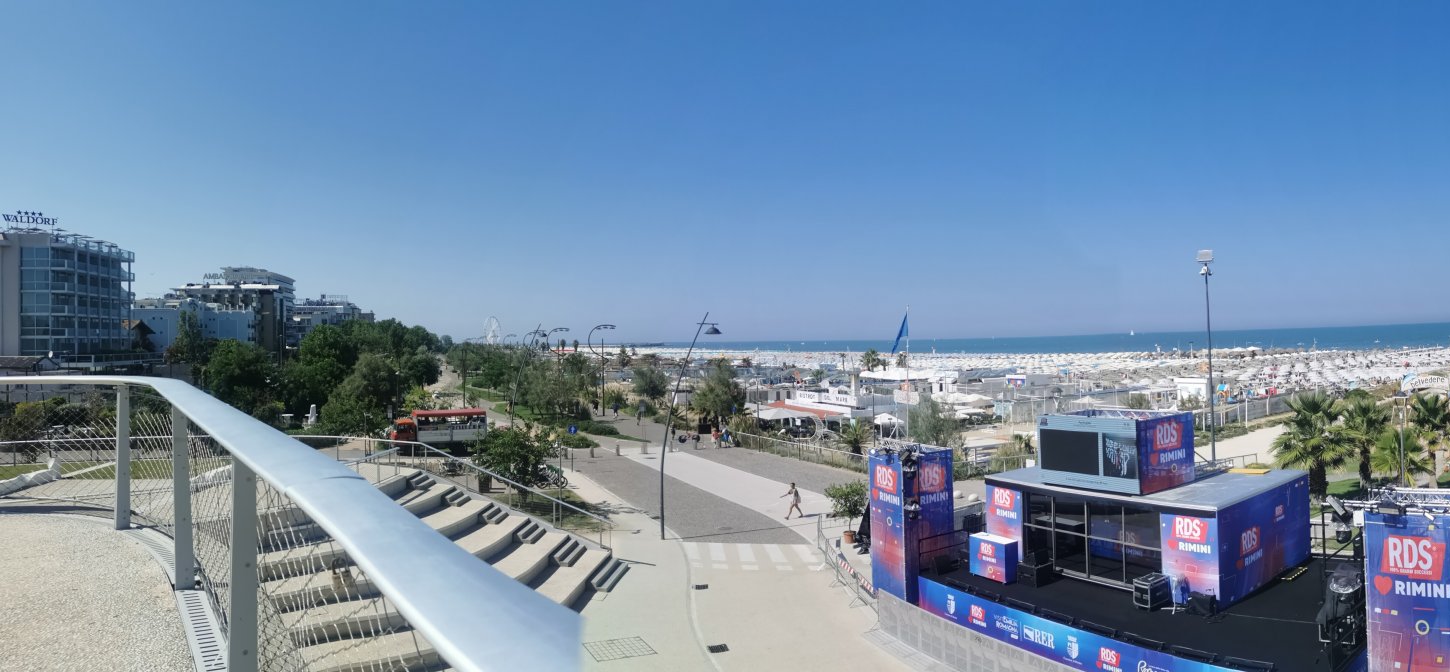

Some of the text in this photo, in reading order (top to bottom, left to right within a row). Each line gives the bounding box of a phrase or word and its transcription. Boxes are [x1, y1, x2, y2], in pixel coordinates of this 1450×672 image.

[2, 213, 58, 226] WALDORF
[1156, 421, 1178, 445] RDS
[1160, 448, 1186, 464] RIMINI
[876, 464, 894, 489] RDS
[879, 490, 900, 507] RIMINI
[920, 491, 949, 505] RIMINI
[994, 486, 1011, 505] RDS
[996, 508, 1017, 519] RIMINI
[1175, 516, 1201, 537] RDS
[1178, 541, 1212, 554] RIMINI
[1241, 526, 1257, 552] RDS
[980, 542, 993, 555] RDS
[1244, 548, 1263, 567] RIMINI
[1388, 536, 1433, 570] RDS
[1034, 628, 1056, 650] RER
[1100, 647, 1117, 664] RDS
